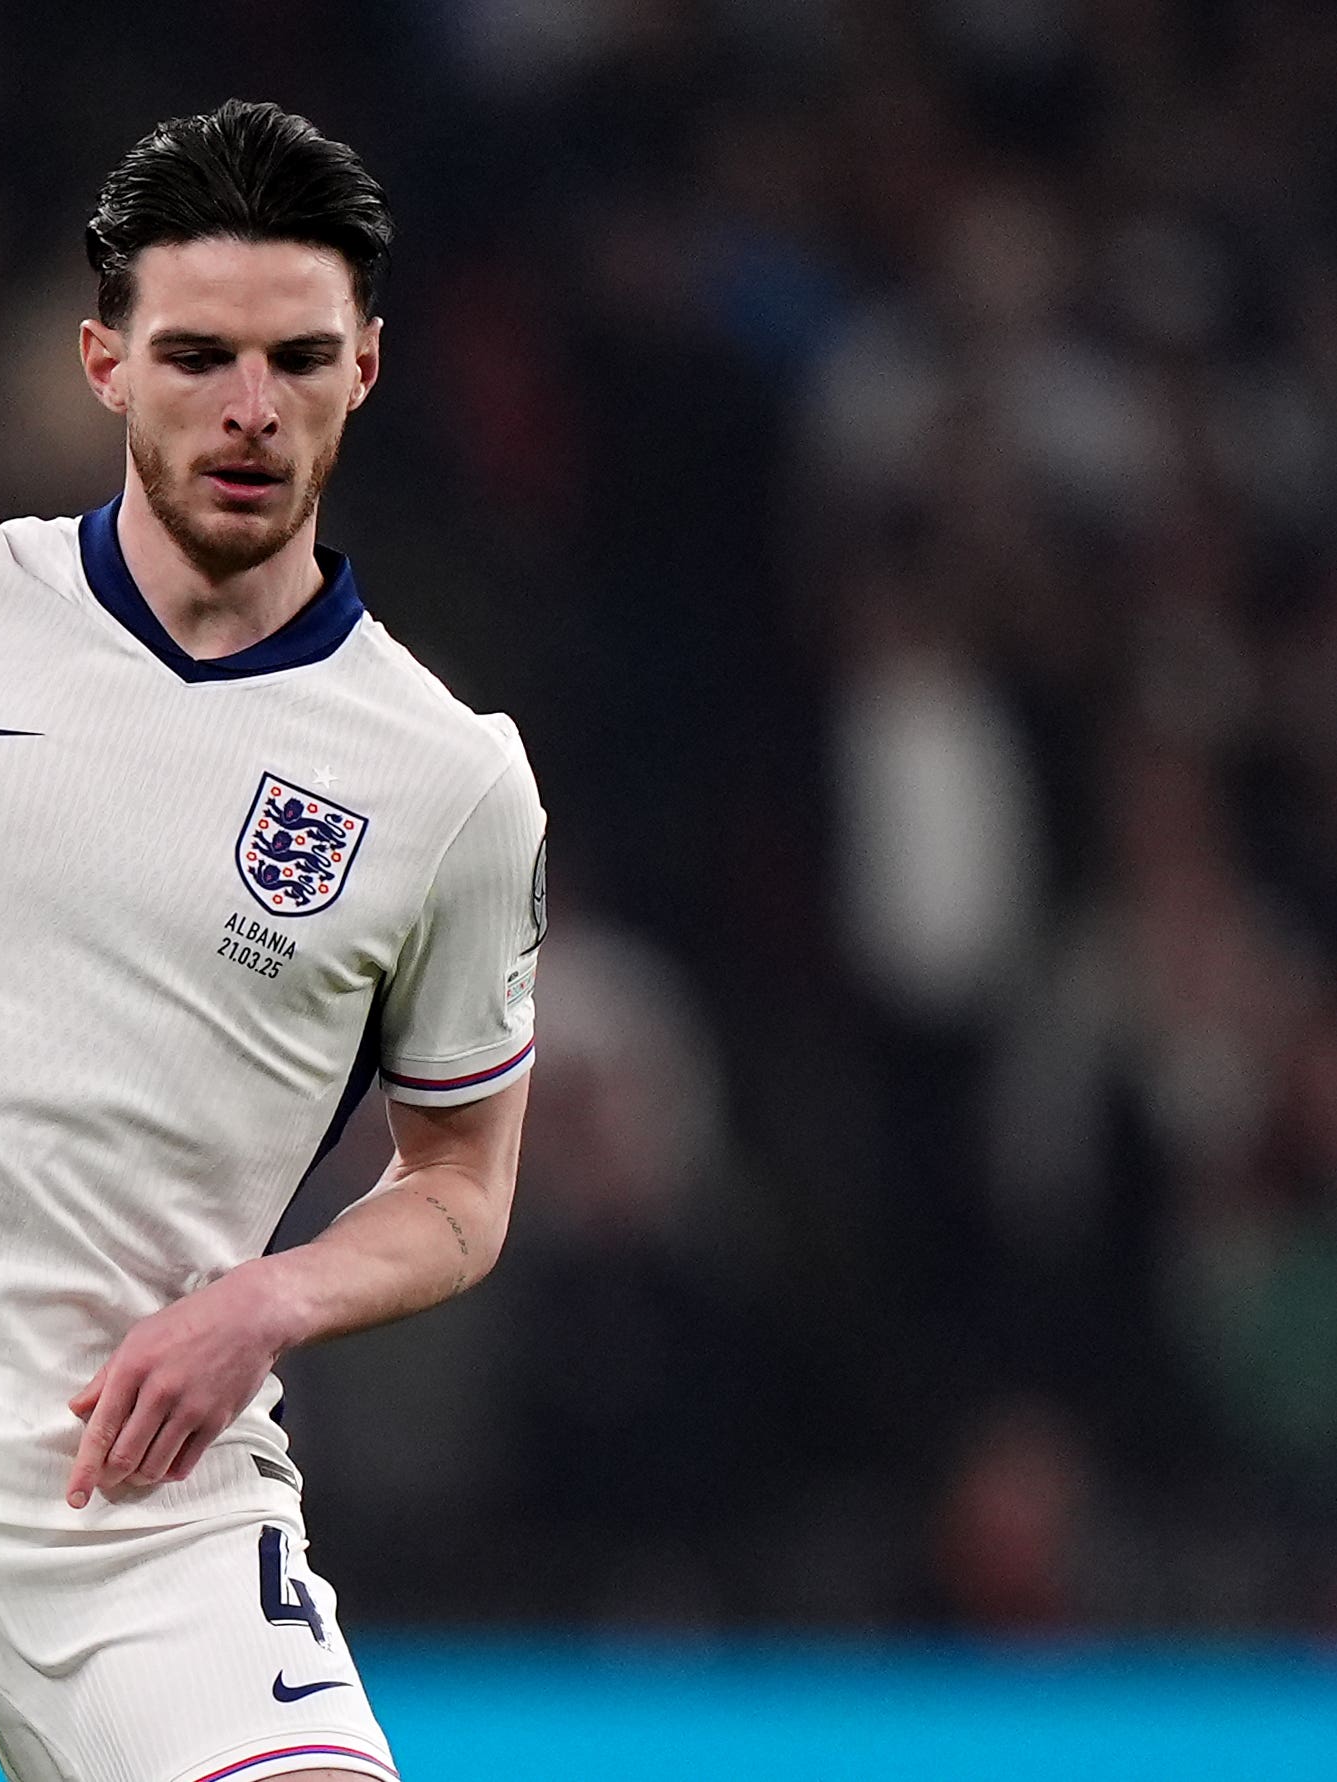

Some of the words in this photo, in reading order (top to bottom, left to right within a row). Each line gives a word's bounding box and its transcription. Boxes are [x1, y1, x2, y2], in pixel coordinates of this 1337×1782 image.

[217, 937, 283, 979] 21.03.25
[224, 912, 296, 960] ALBANIA
[258, 1524, 330, 1650] 4
